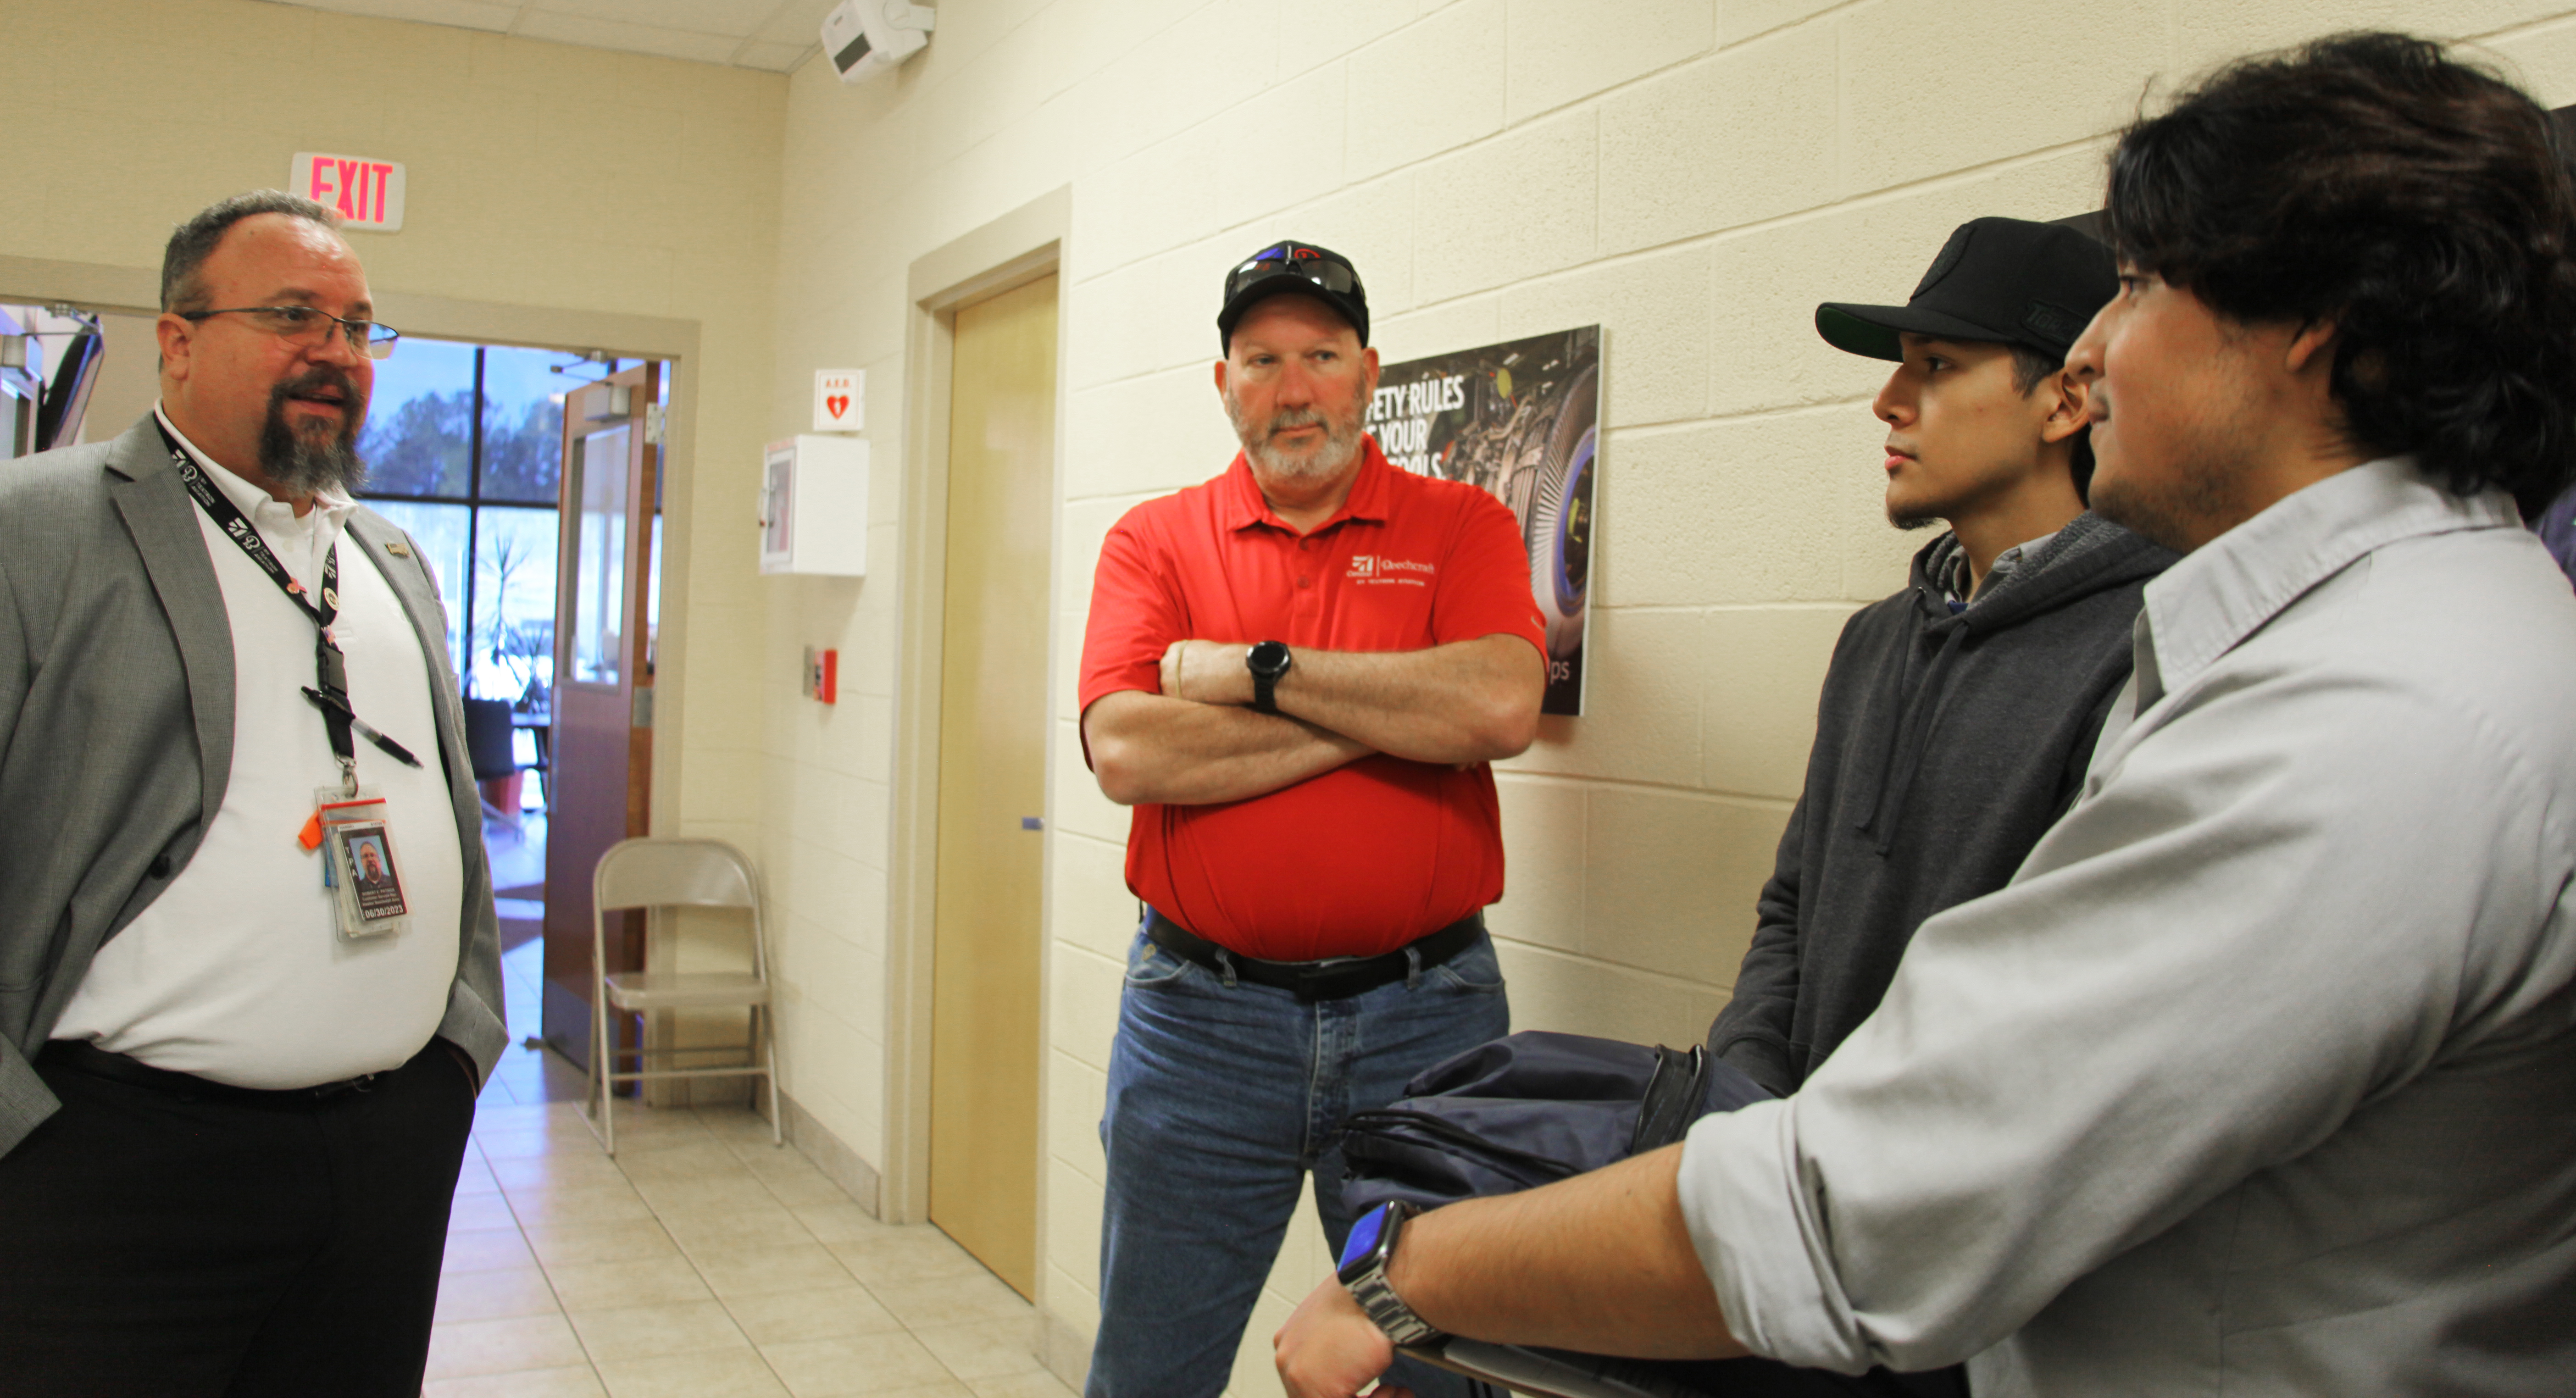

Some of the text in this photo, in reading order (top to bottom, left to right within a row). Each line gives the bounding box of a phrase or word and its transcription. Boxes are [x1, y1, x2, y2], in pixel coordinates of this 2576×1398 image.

[309, 155, 393, 224] EXIT
[1409, 374, 1465, 416] RULES
[1379, 418, 1427, 455] YOUR
[1550, 661, 1570, 685] ps
[365, 904, 404, 919] 06/30/2023
